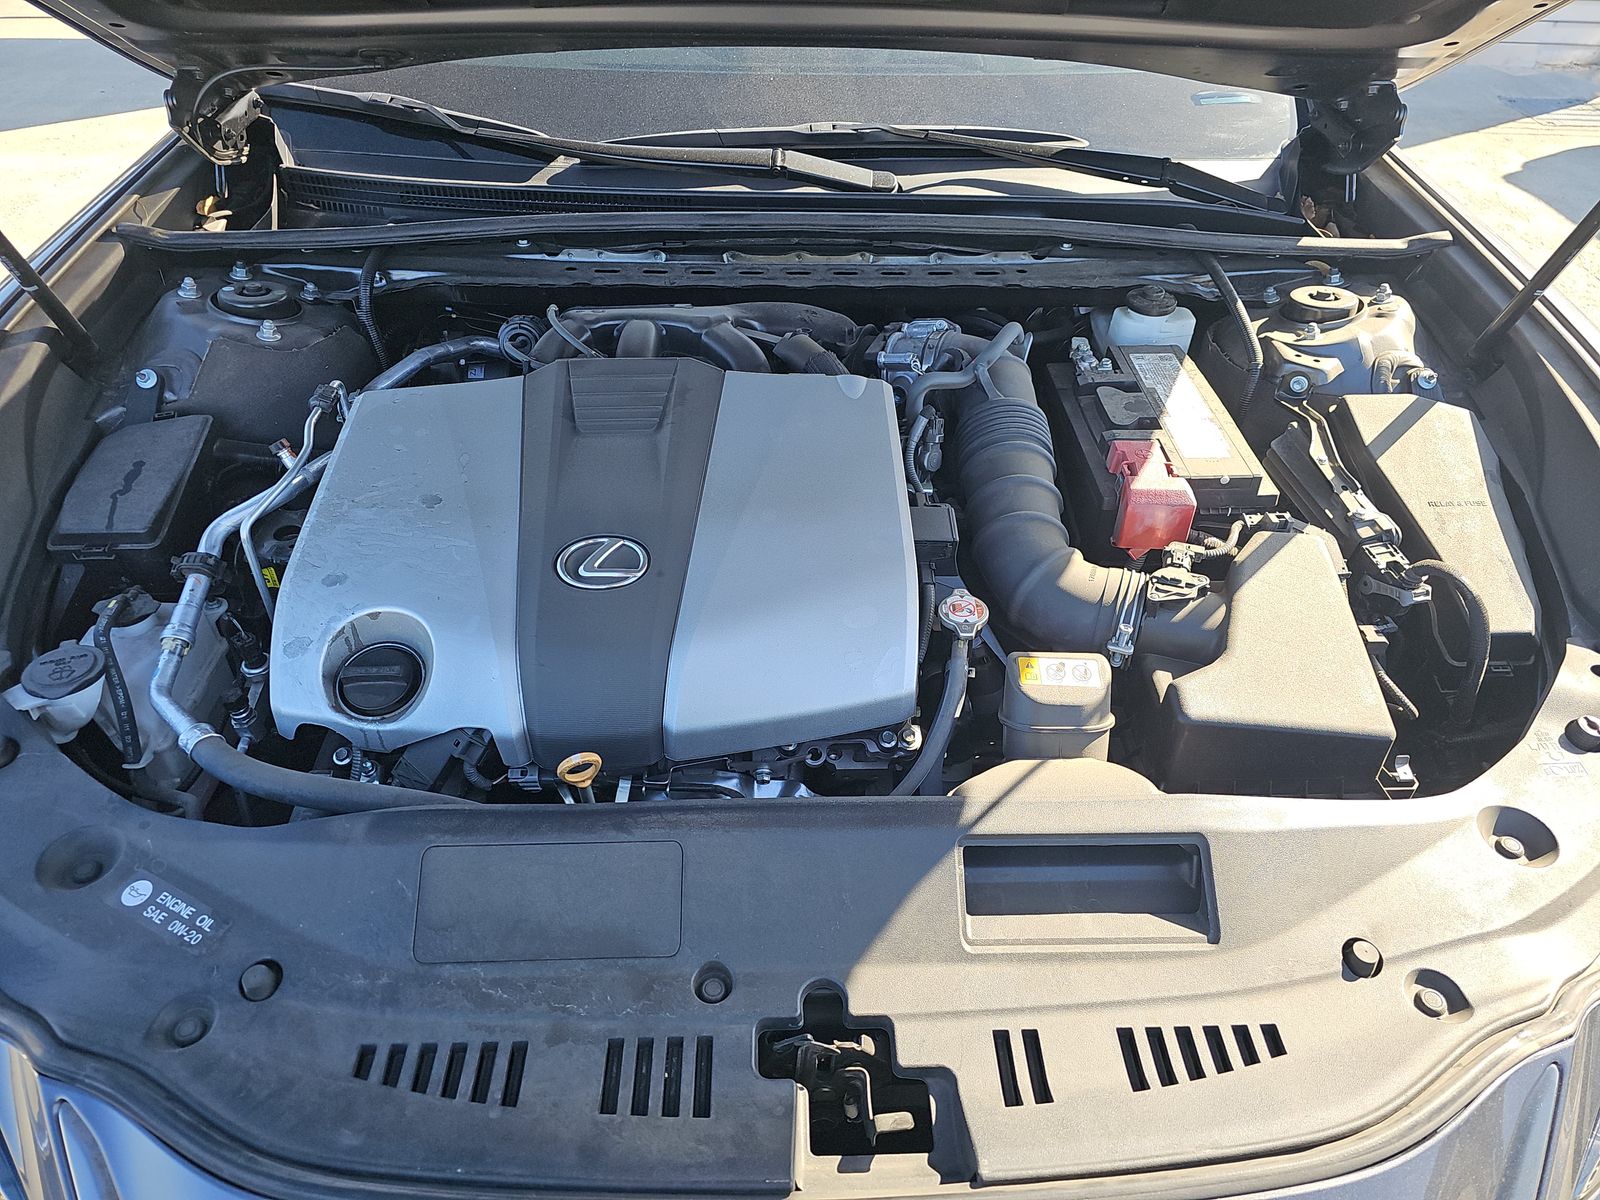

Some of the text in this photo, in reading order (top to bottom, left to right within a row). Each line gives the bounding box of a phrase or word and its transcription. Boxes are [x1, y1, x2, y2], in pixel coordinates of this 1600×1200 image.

[1427, 500, 1455, 508] RELAY
[143, 906, 203, 945] SAE 0W-20
[156, 892, 214, 932] ENGINE OIL
